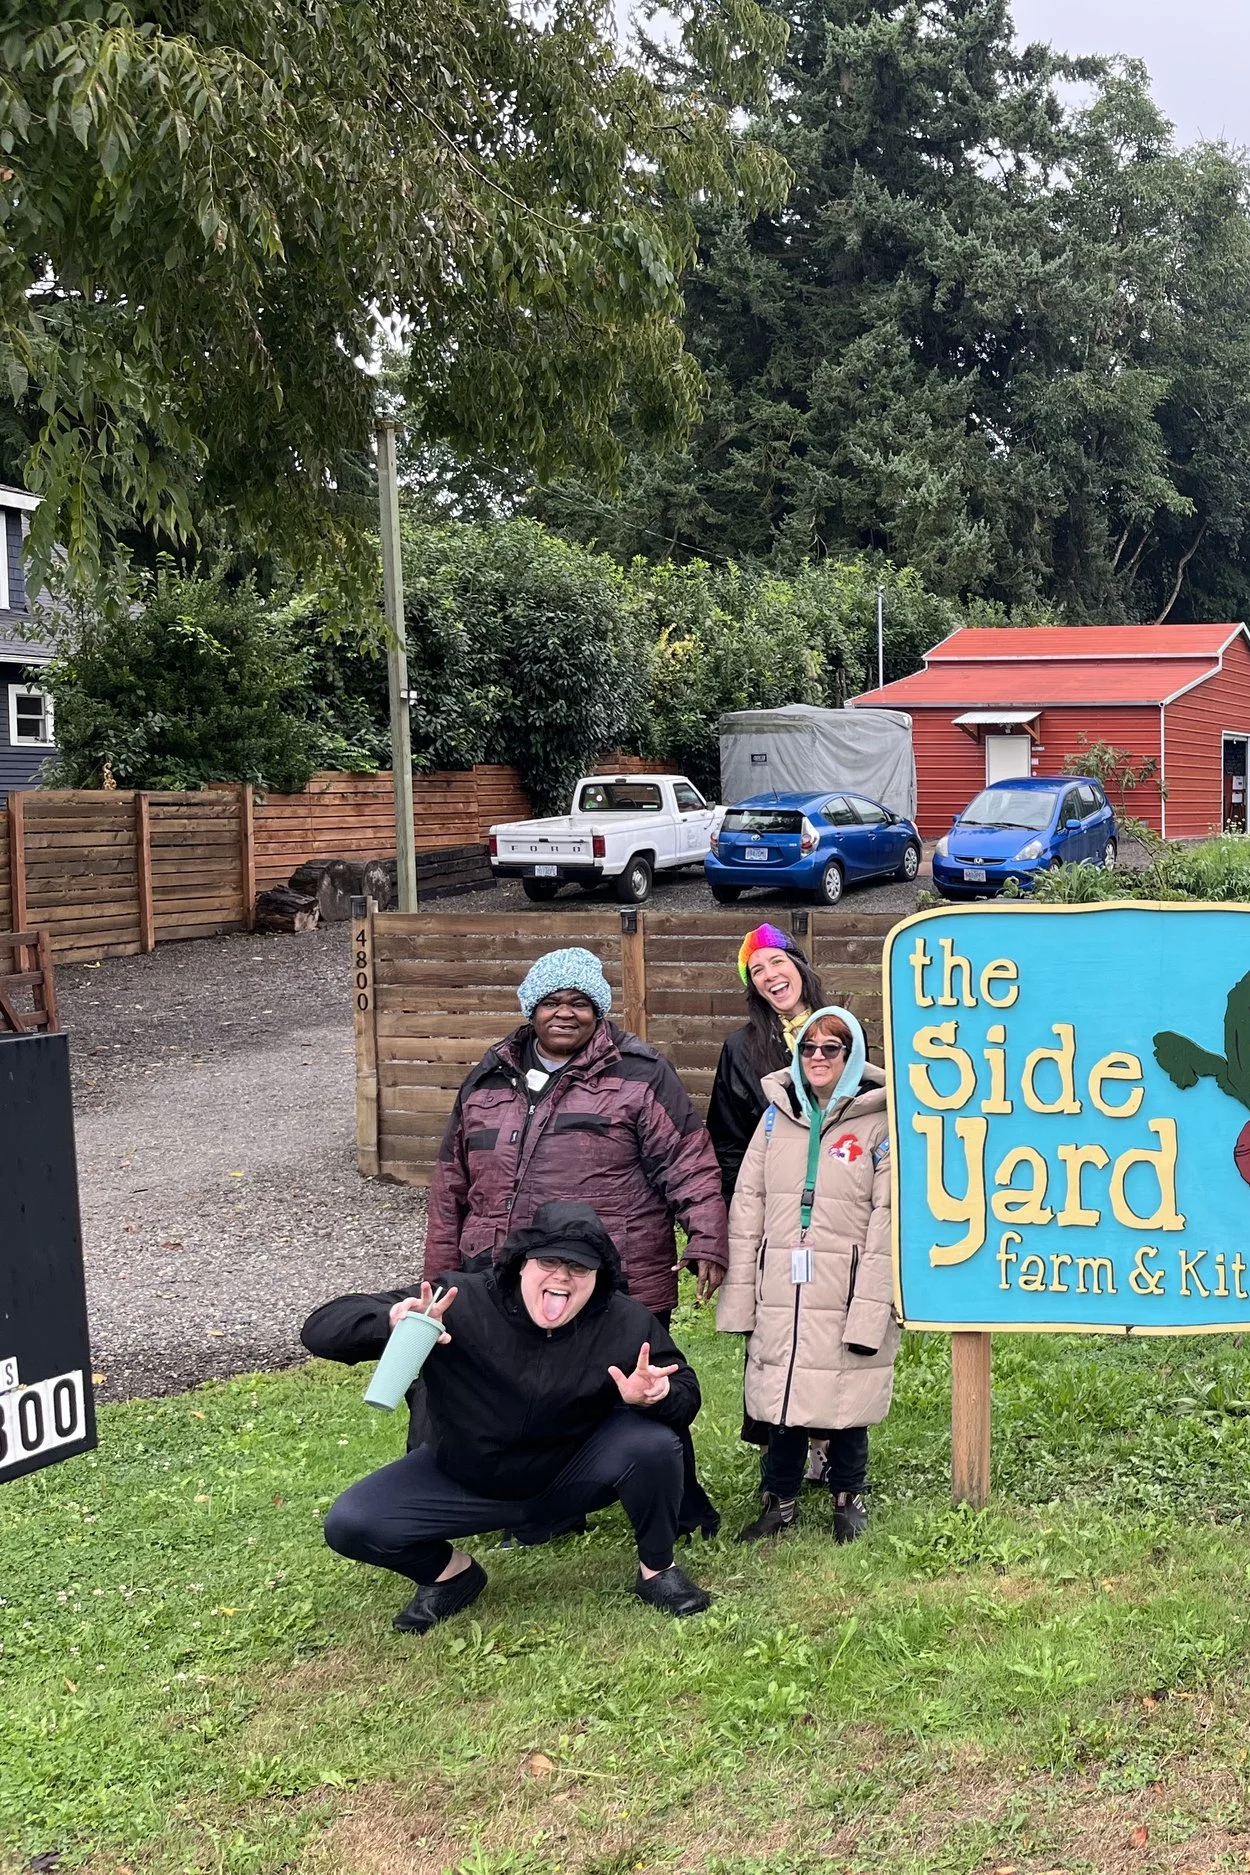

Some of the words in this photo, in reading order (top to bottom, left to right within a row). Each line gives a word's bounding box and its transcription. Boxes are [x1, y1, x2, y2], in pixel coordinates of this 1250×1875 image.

[511, 844, 582, 853] FORD
[356, 929, 369, 1011] 4800
[909, 937, 1019, 1008] the
[908, 1021, 1144, 1118] Side
[911, 1111, 1186, 1267] Yard
[996, 1231, 1117, 1294] farm
[1128, 1245, 1165, 1295] &
